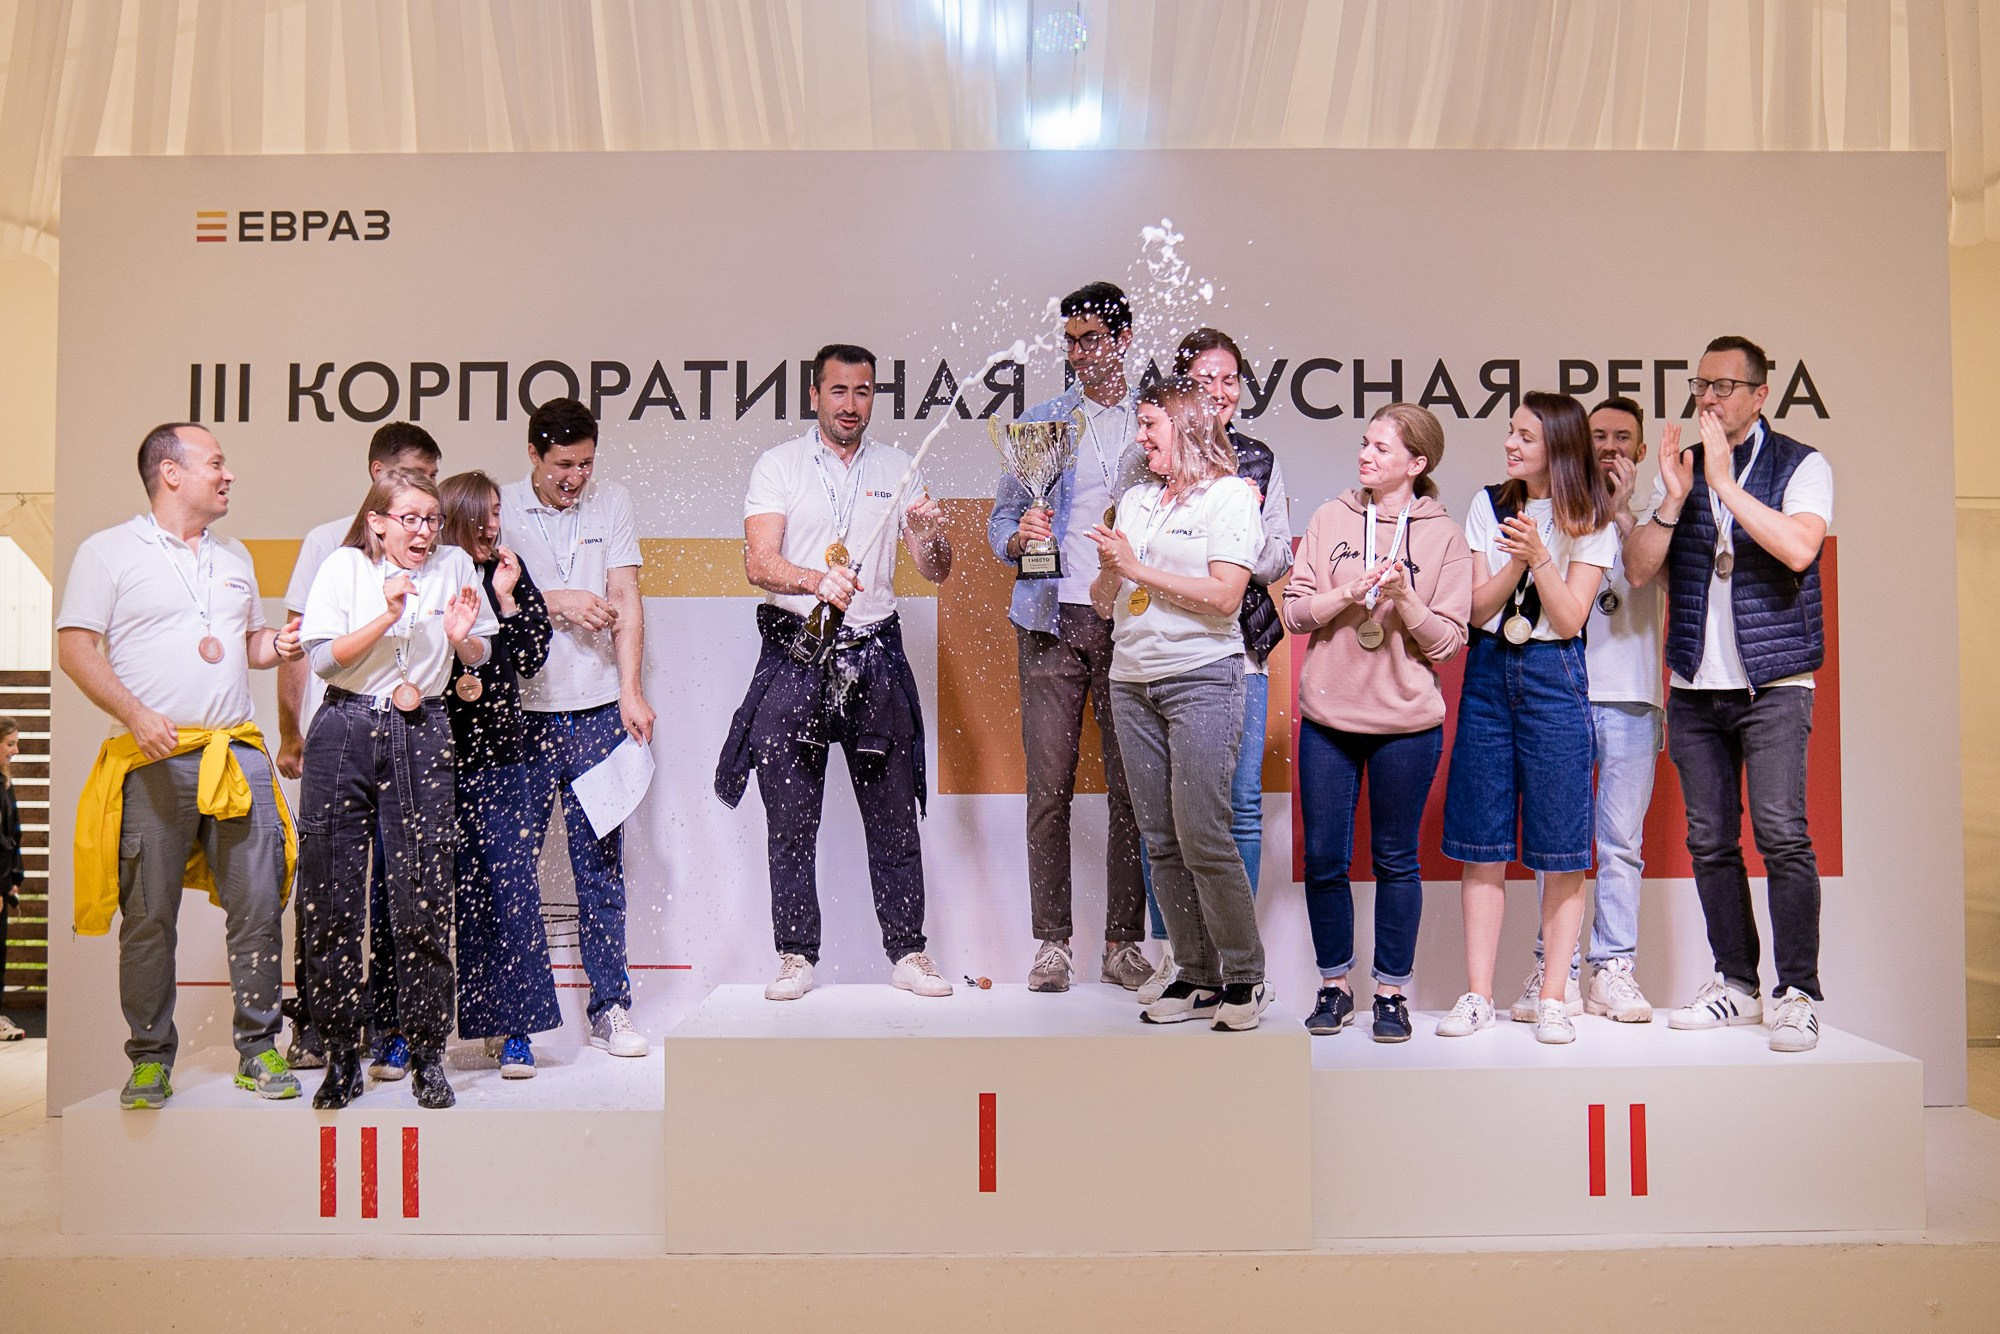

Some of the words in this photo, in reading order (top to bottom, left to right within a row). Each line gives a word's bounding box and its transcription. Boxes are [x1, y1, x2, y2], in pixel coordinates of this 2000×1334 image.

[238, 210, 391, 242] ЕВРАЗ
[189, 363, 251, 423] III
[1065, 356, 1522, 422] УСНАЯ
[1558, 356, 1831, 420] РЕГА
[320, 1126, 419, 1219] III
[979, 1093, 997, 1193] I
[1588, 1104, 1648, 1197] II
